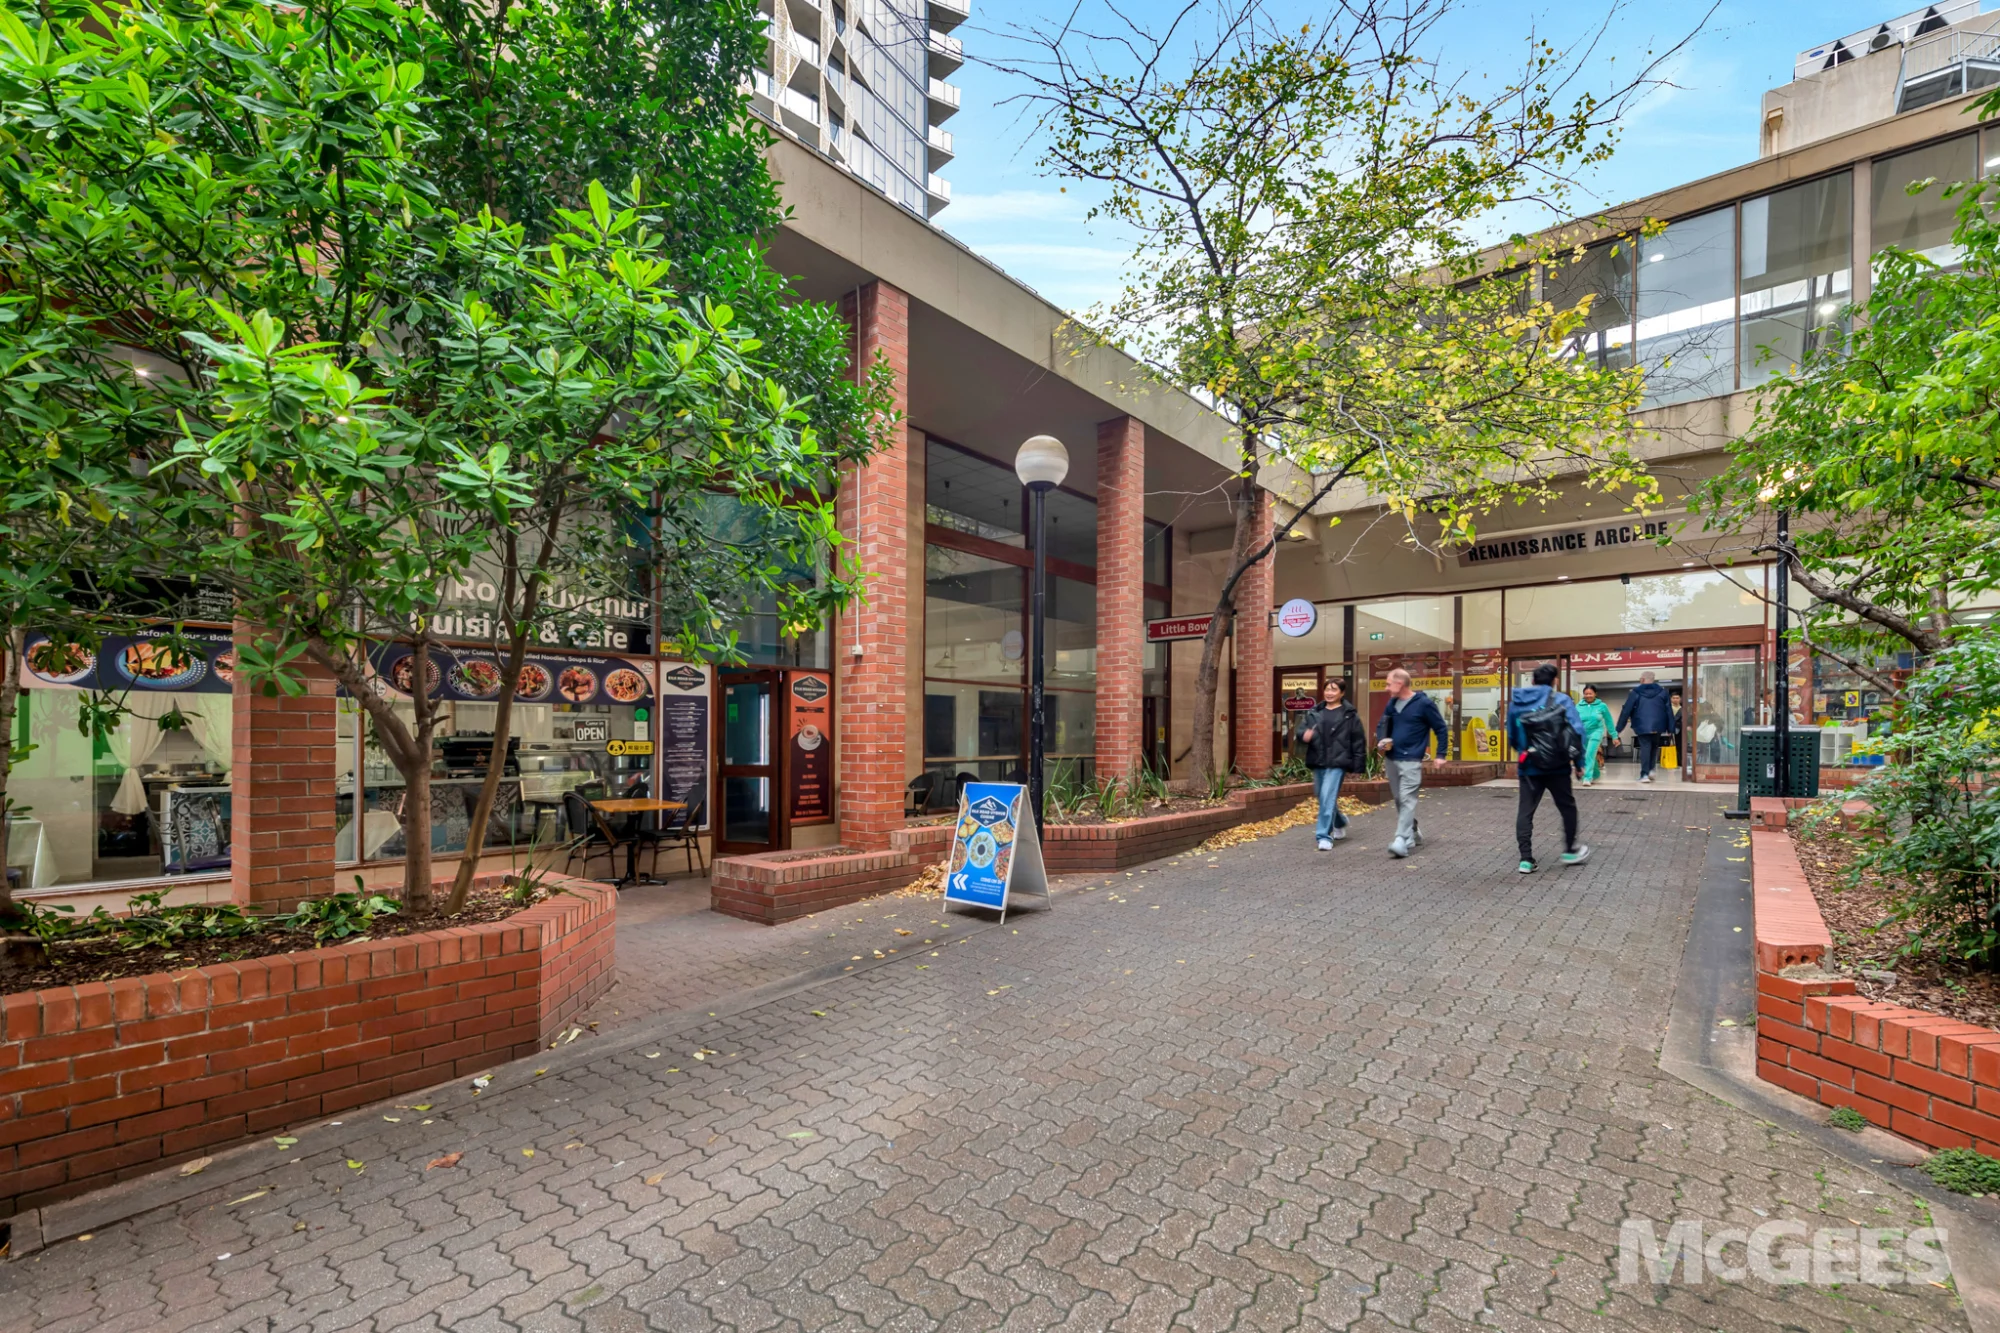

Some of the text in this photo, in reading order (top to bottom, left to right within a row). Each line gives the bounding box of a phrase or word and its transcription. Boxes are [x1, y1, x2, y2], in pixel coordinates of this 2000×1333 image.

[1469, 532, 1587, 562] RENAISSANCE
[539, 620, 560, 643] &
[1160, 620, 1212, 635] Little Bow
[577, 727, 604, 741] OPEN
[1489, 735, 1498, 747] 8
